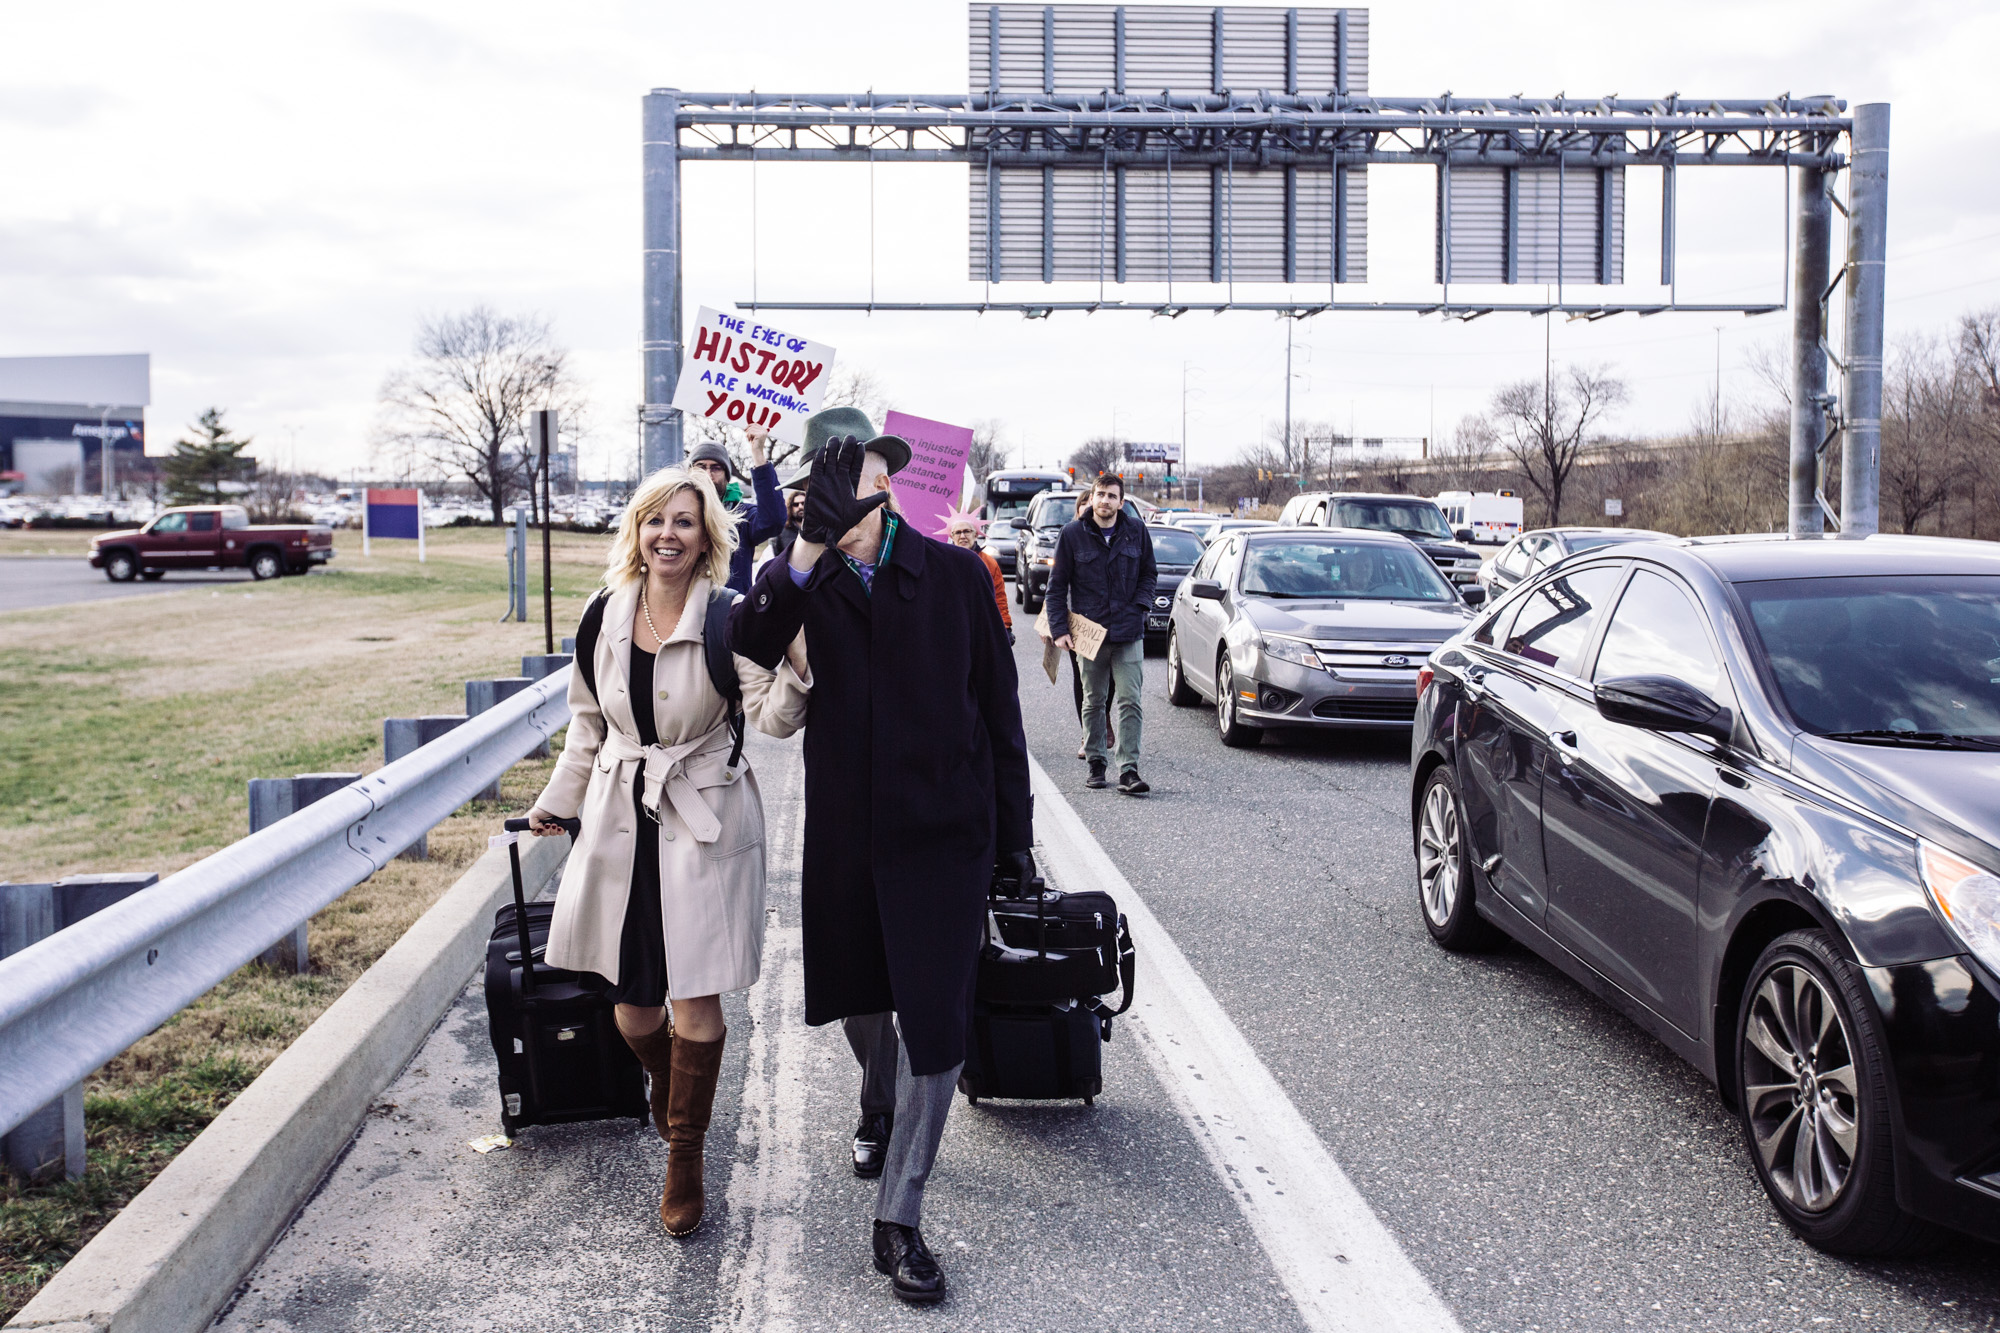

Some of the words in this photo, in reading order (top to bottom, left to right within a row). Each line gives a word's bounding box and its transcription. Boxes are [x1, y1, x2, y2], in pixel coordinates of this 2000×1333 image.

[718, 314, 745, 334] THE
[751, 325, 785, 347] EYES
[786, 338, 807, 353] OF
[693, 326, 823, 396] HISTORY
[700, 369, 739, 391] ARE
[746, 383, 810, 413] WATCHING
[704, 390, 782, 432] YOU!
[918, 438, 964, 457] injustice
[902, 464, 947, 481] sistance
[937, 458, 958, 470] law
[889, 476, 927, 491] comes
[929, 484, 954, 498] duty
[1388, 656, 1405, 665] Ford
